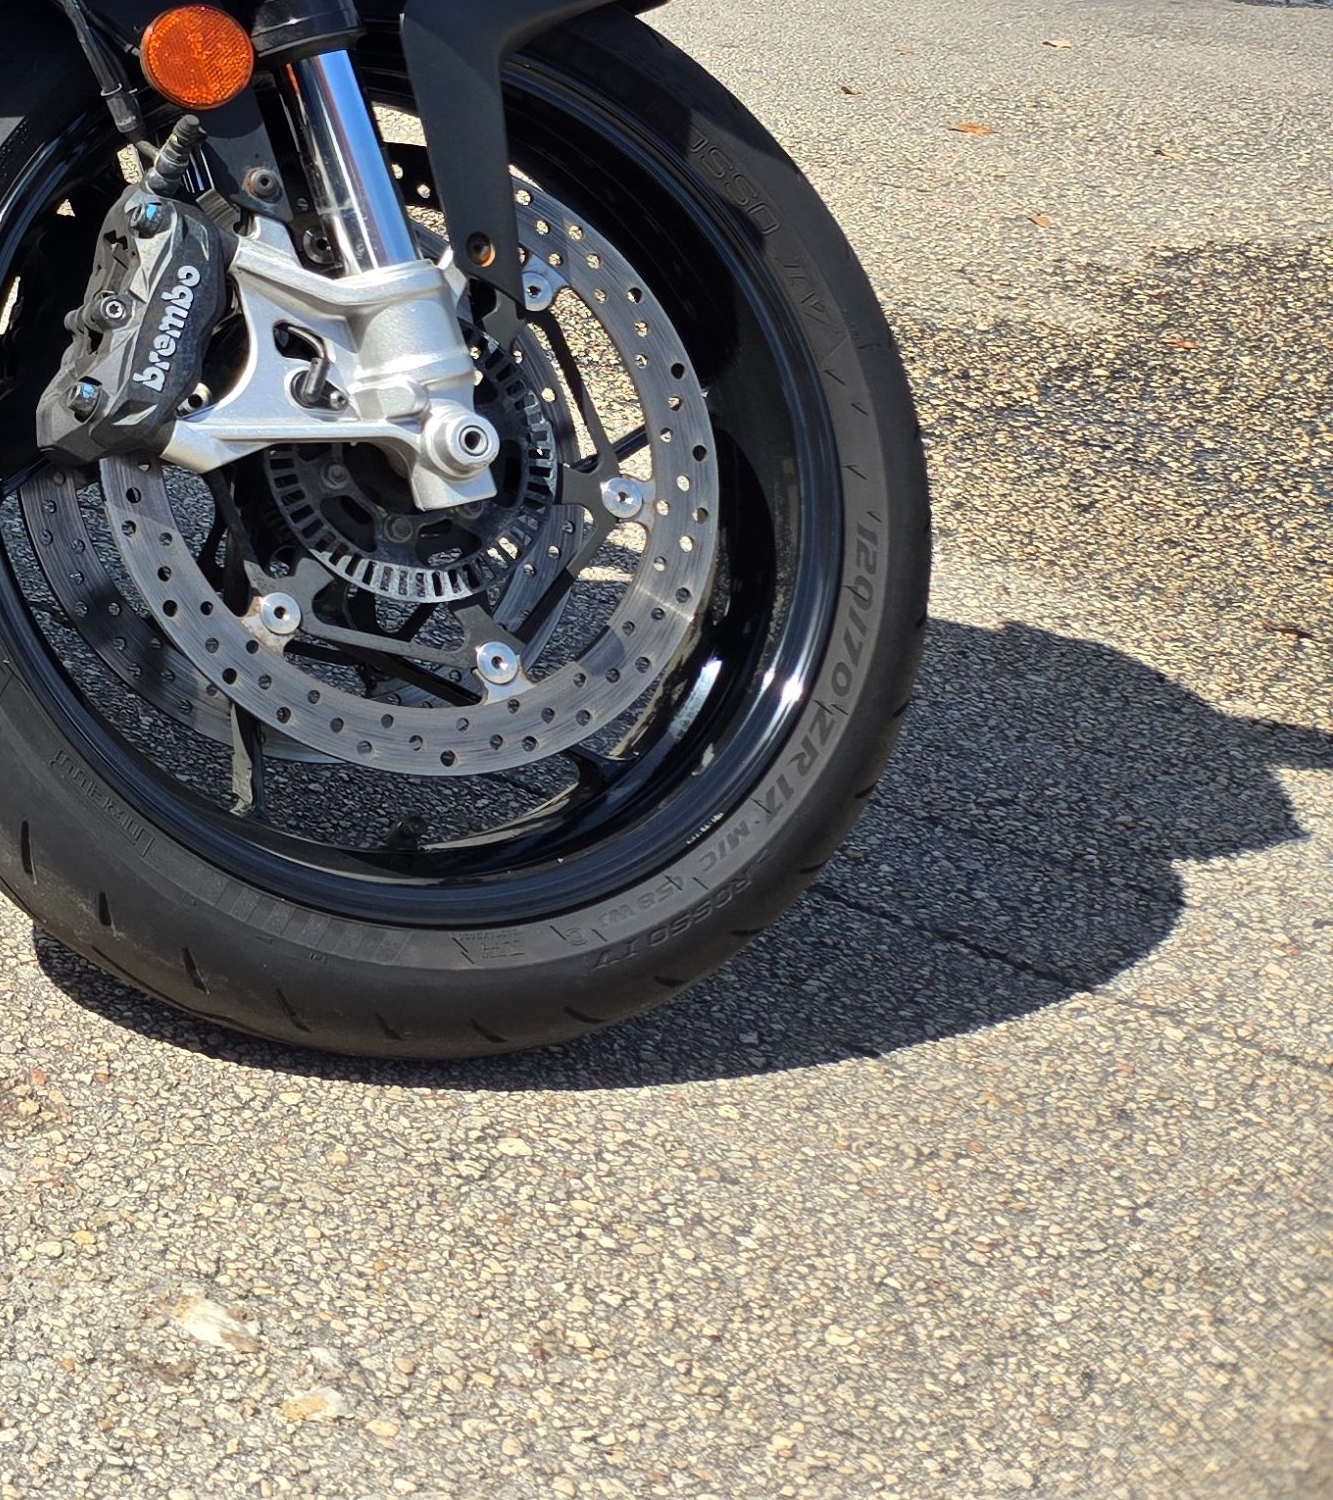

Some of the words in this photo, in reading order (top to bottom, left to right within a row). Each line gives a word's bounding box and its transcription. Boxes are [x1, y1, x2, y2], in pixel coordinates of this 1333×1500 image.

[133, 265, 200, 392] brembo
[830, 521, 880, 699] 120/70
[648, 865, 753, 949] ROSSO
